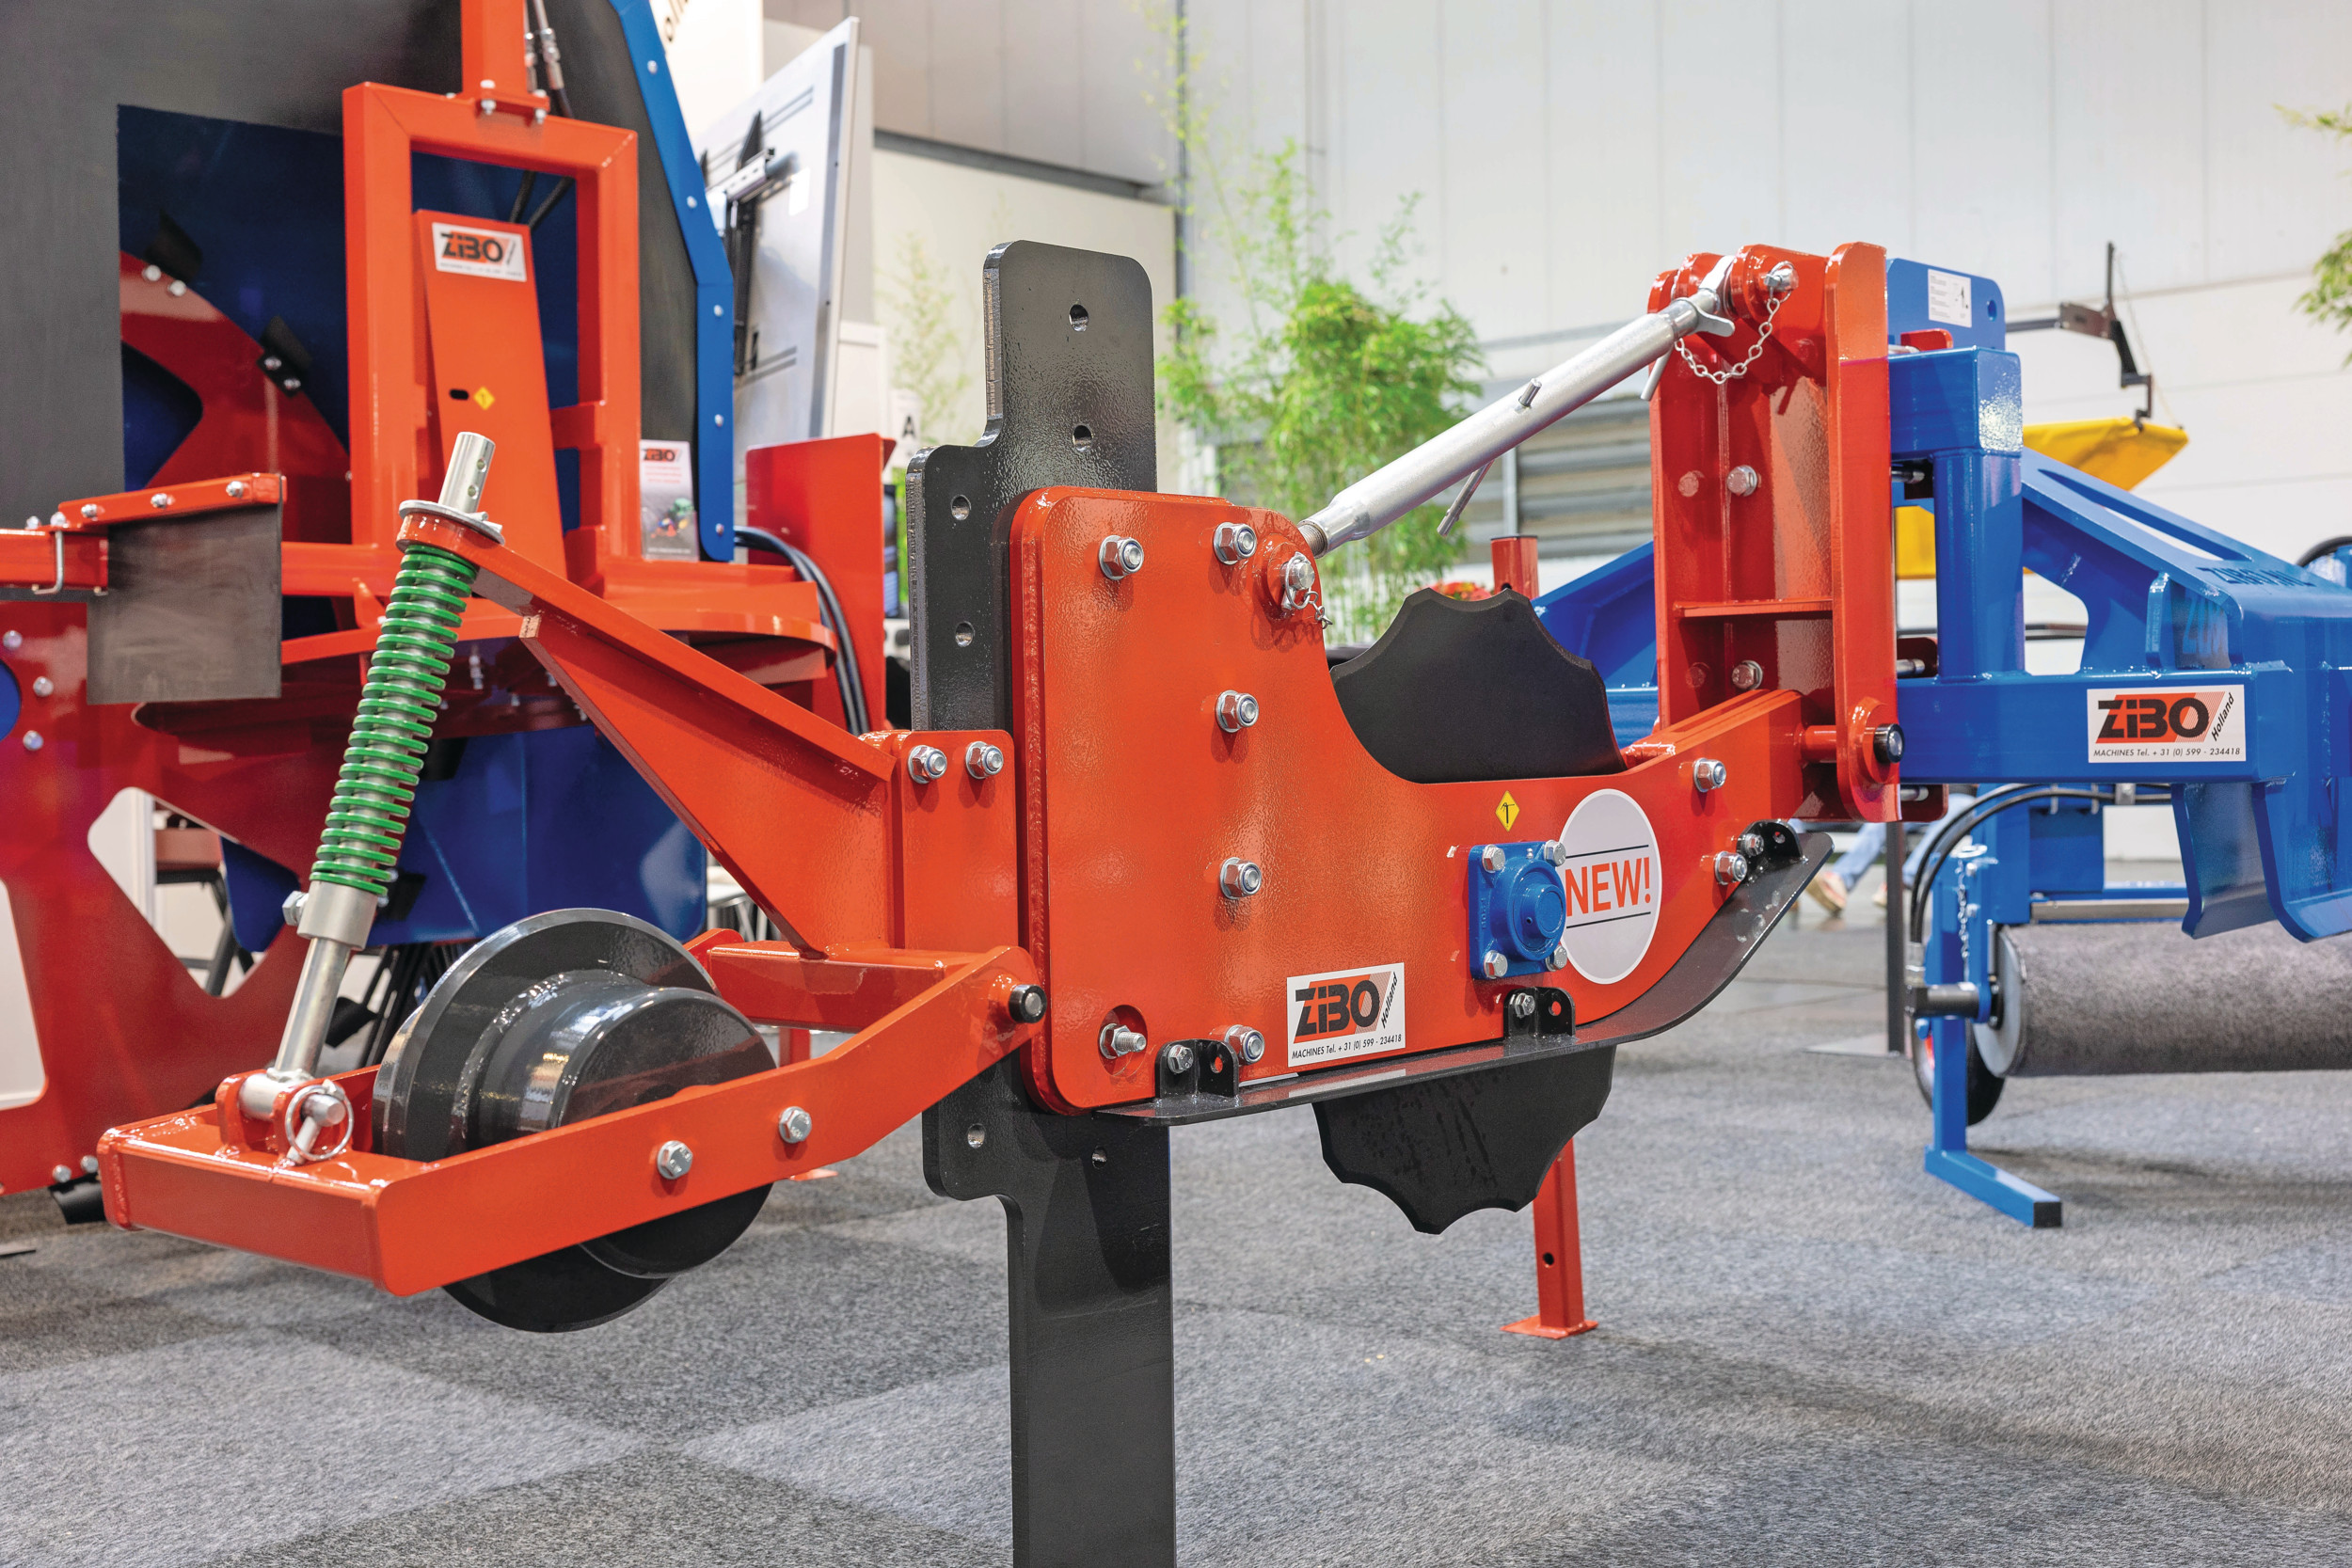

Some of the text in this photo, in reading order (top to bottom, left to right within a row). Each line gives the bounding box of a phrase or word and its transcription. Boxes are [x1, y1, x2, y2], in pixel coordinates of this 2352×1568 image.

[2211, 692, 2234, 741] Holland
[2093, 749, 2135, 757] MACHINES
[2172, 748, 2183, 757] (0)
[2185, 748, 2201, 756] 599
[2209, 747, 2241, 756] 234418
[1565, 857, 1651, 917] NEW!
[1381, 972, 1398, 1029] Holland
[1292, 1046, 1325, 1058] MACHINES
[1326, 1044, 1337, 1053] Tel.
[1343, 1042, 1352, 1051] 31
[1353, 1040, 1361, 1051] (0)
[1362, 1038, 1375, 1048] 599
[1379, 1034, 1402, 1045] 234418
